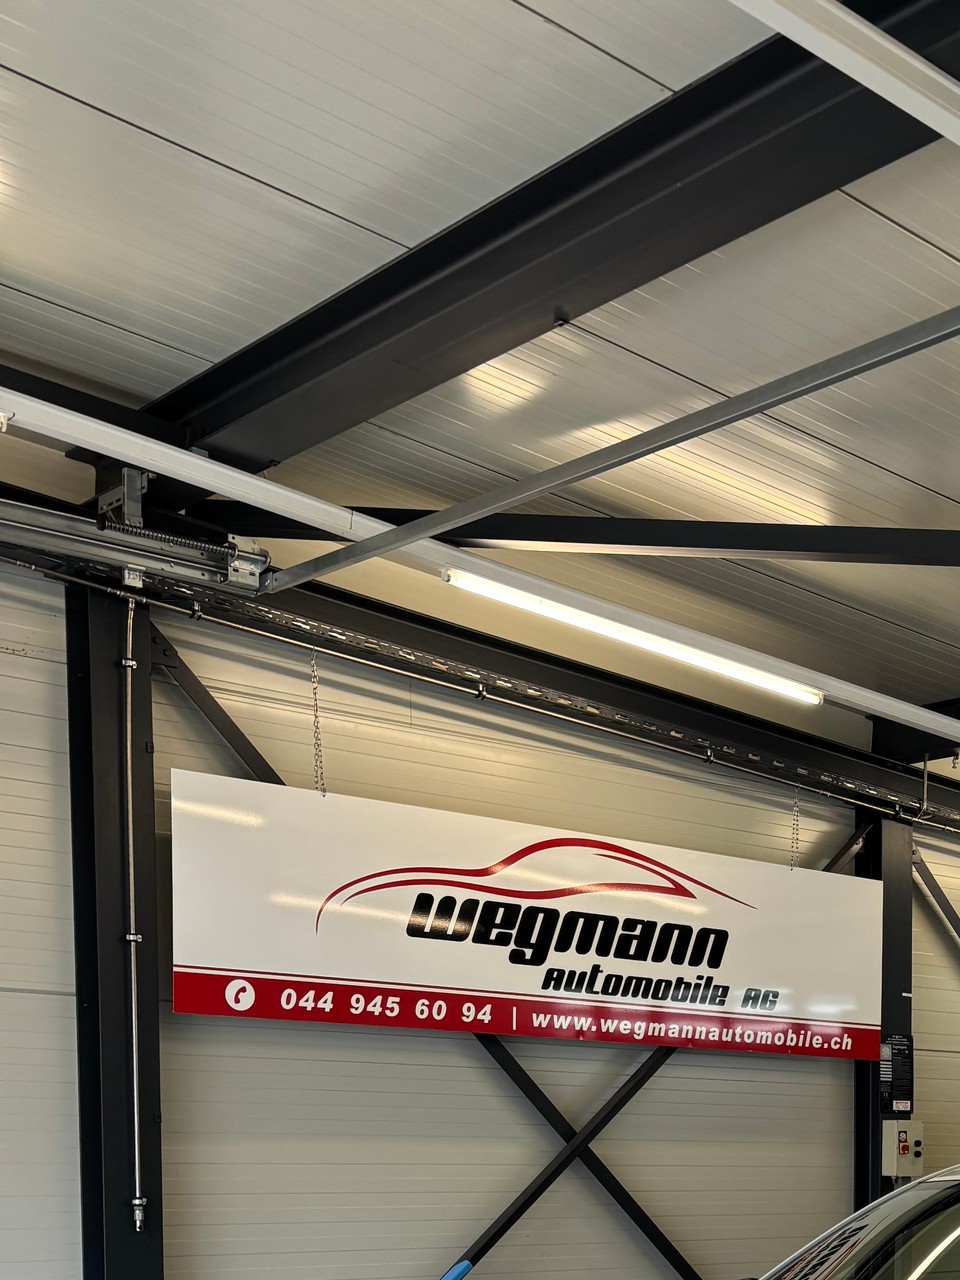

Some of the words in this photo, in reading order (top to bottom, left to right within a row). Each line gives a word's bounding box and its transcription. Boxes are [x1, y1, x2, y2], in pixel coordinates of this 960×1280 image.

[406, 892, 729, 969] wegmann
[280, 988, 334, 1012] 044
[350, 993, 400, 1018] 945
[415, 998, 447, 1020] 60
[461, 1002, 492, 1024] 94
[531, 1012, 852, 1051] www.wegmannautomobile.ch
[741, 987, 780, 1011] AG
